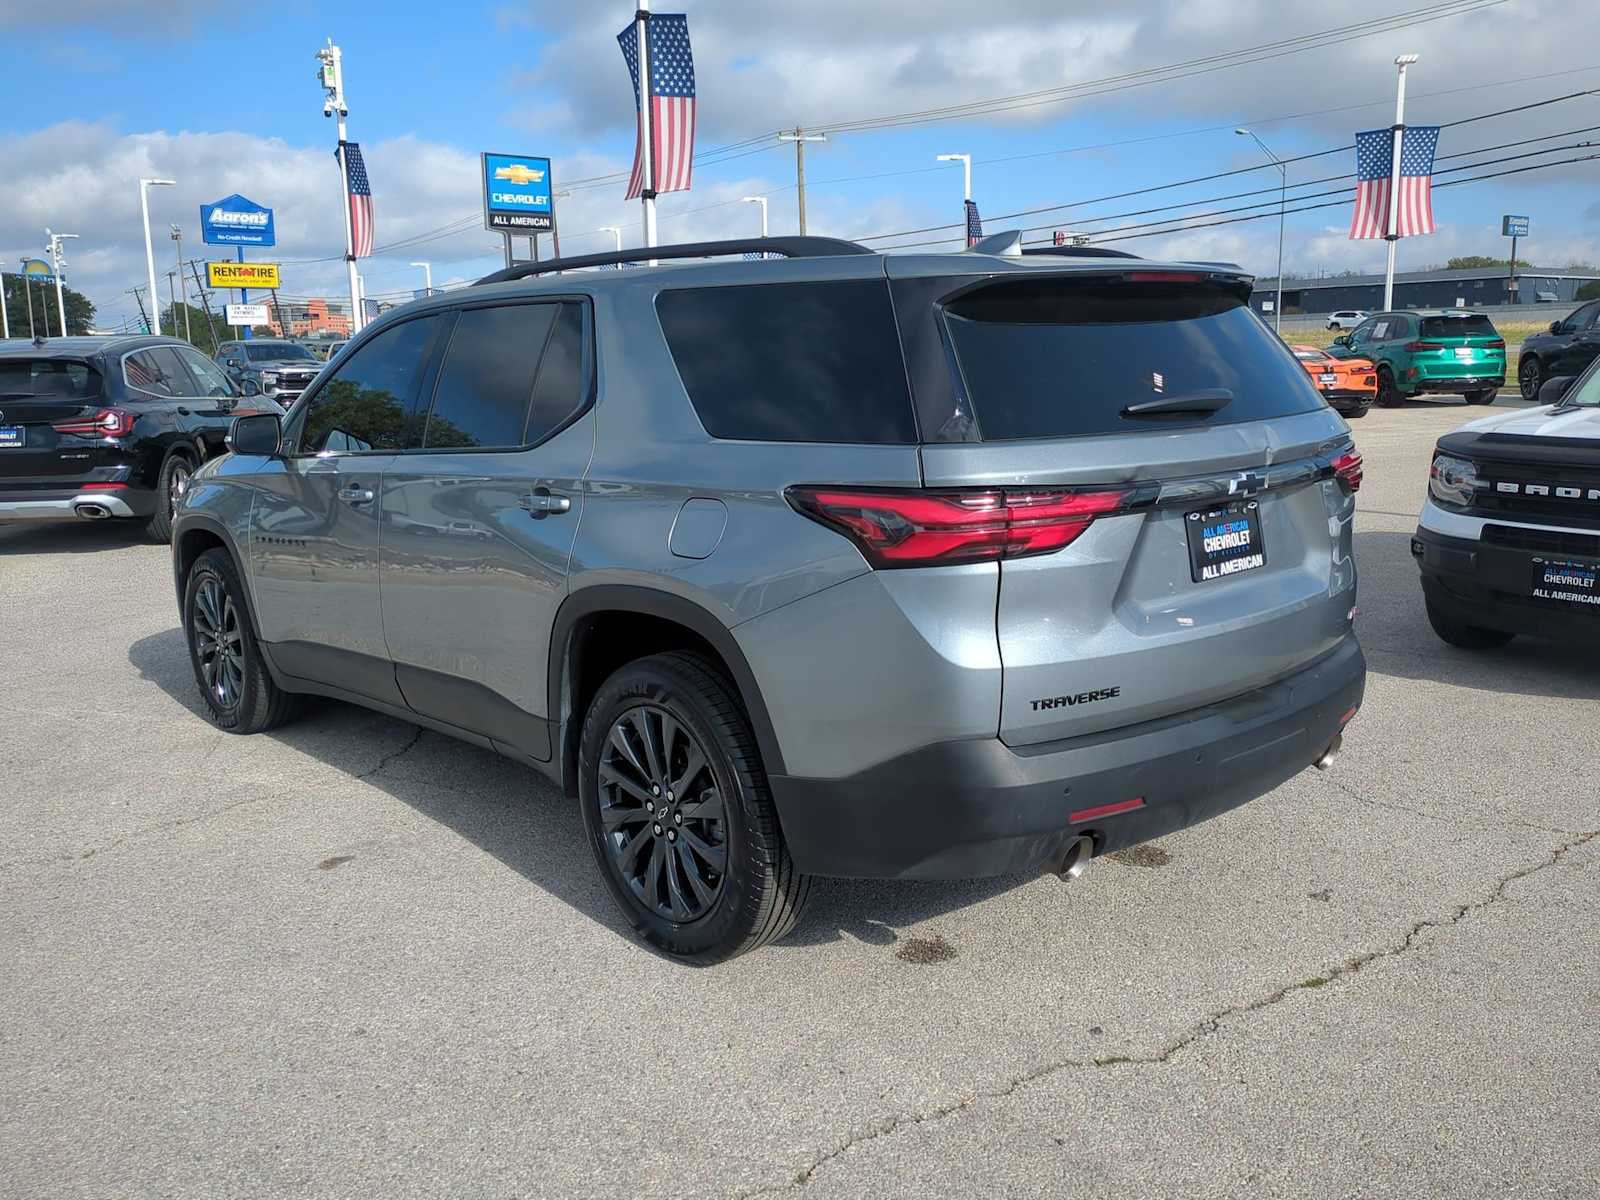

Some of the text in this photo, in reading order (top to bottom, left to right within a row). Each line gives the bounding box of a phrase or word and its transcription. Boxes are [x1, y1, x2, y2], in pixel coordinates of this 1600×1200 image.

[493, 193, 548, 205] CHEVROLET
[209, 208, 269, 225] Aaron's
[494, 216, 550, 227] ALL AMERICAN
[213, 267, 241, 277] RENT
[1203, 520, 1248, 538] ALL AMERICAN
[1204, 530, 1250, 553] CHEVROLET
[1203, 554, 1263, 580] ALL AMERICAN
[1544, 574, 1595, 588] CHEVROLET
[1533, 589, 1550, 599] ALL
[1030, 686, 1121, 711] TRAVERSE
